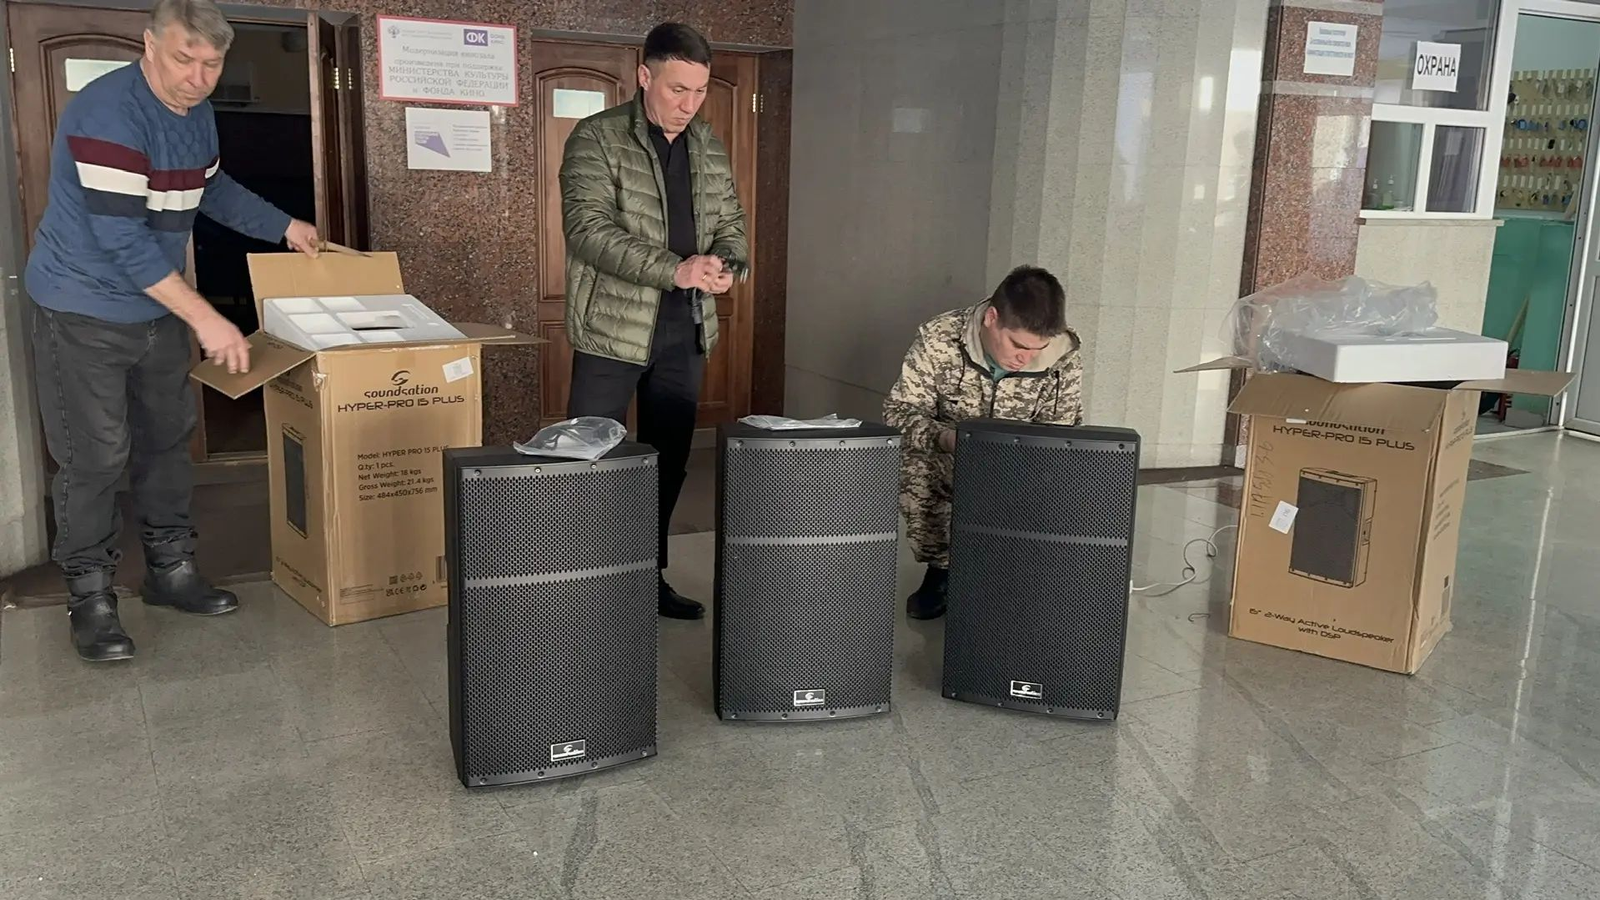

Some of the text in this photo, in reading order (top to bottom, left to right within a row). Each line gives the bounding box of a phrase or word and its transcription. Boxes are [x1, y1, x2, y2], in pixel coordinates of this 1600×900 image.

[466, 31, 486, 45] ФК
[1416, 53, 1456, 77] ОХРАНА
[388, 66, 509, 81] МИНИСТЕРСТВА КУЛЬТУРЫ
[389, 75, 509, 90] РОССИЙСКОЙ ФЕДЕРАЦИИ
[423, 86, 455, 96] ФОНДА
[460, 89, 485, 97] КИНО
[364, 384, 439, 399] soundsation
[337, 399, 414, 413] HYPER-PRO
[432, 395, 465, 405] PLUS
[1273, 425, 1355, 444] HYPER-PRO
[1375, 438, 1415, 451] PLUS
[357, 452, 380, 461] Model:
[382, 448, 406, 459] HYPER
[408, 447, 422, 456] PRO
[358, 473, 371, 481] Net
[373, 469, 399, 480] Weight:
[410, 468, 422, 476] kgs
[358, 483, 378, 491] Gross
[379, 479, 406, 489] Weight:
[423, 476, 434, 485] kgs
[358, 494, 375, 502] Size:
[1264, 611, 1296, 624] 2-Way
[1297, 618, 1330, 630] Active
[1332, 625, 1395, 644] Loudspeaker
[1298, 626, 1341, 640] with DSP
